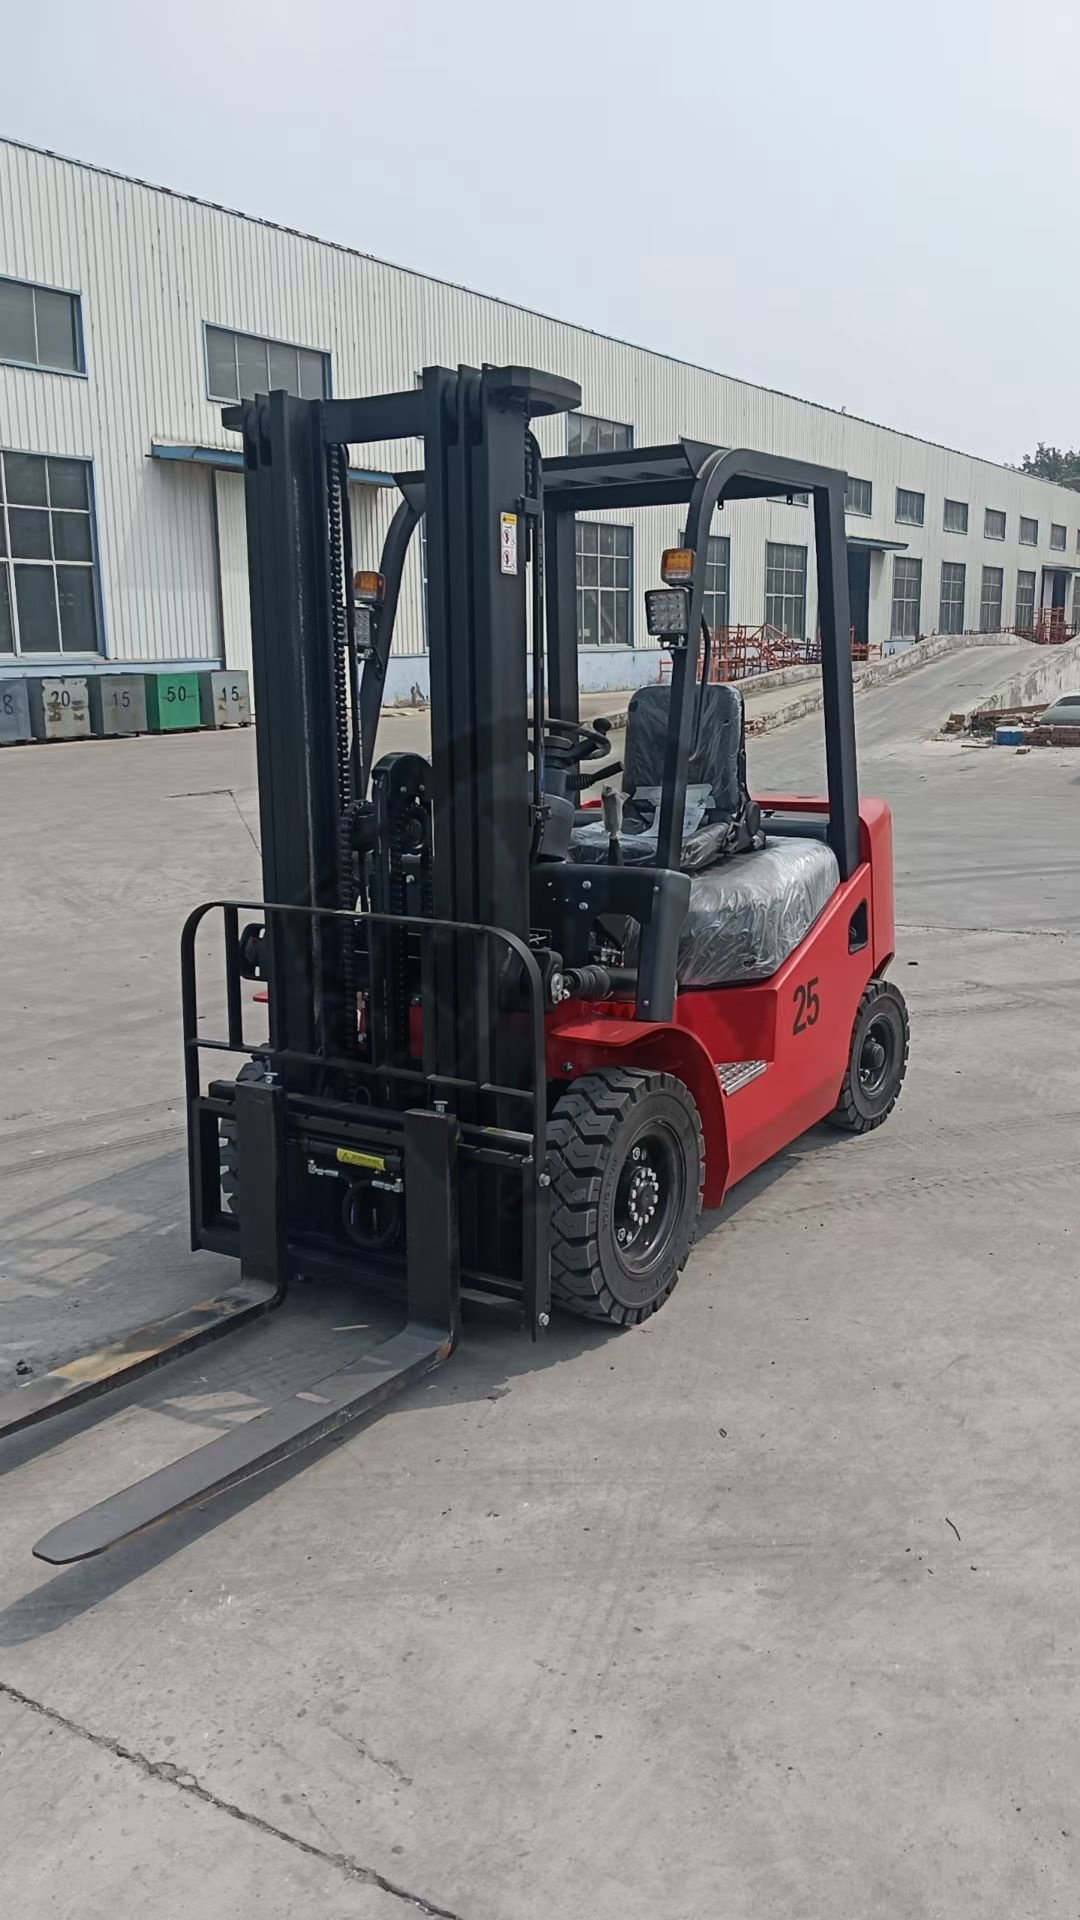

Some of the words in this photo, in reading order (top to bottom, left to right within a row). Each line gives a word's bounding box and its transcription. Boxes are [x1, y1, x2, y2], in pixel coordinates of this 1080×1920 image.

[51, 691, 71, 707] 20
[112, 692, 130, 707] 15
[167, 686, 187, 702] 50
[222, 686, 240, 702] 15
[793, 976, 820, 1036] 25
